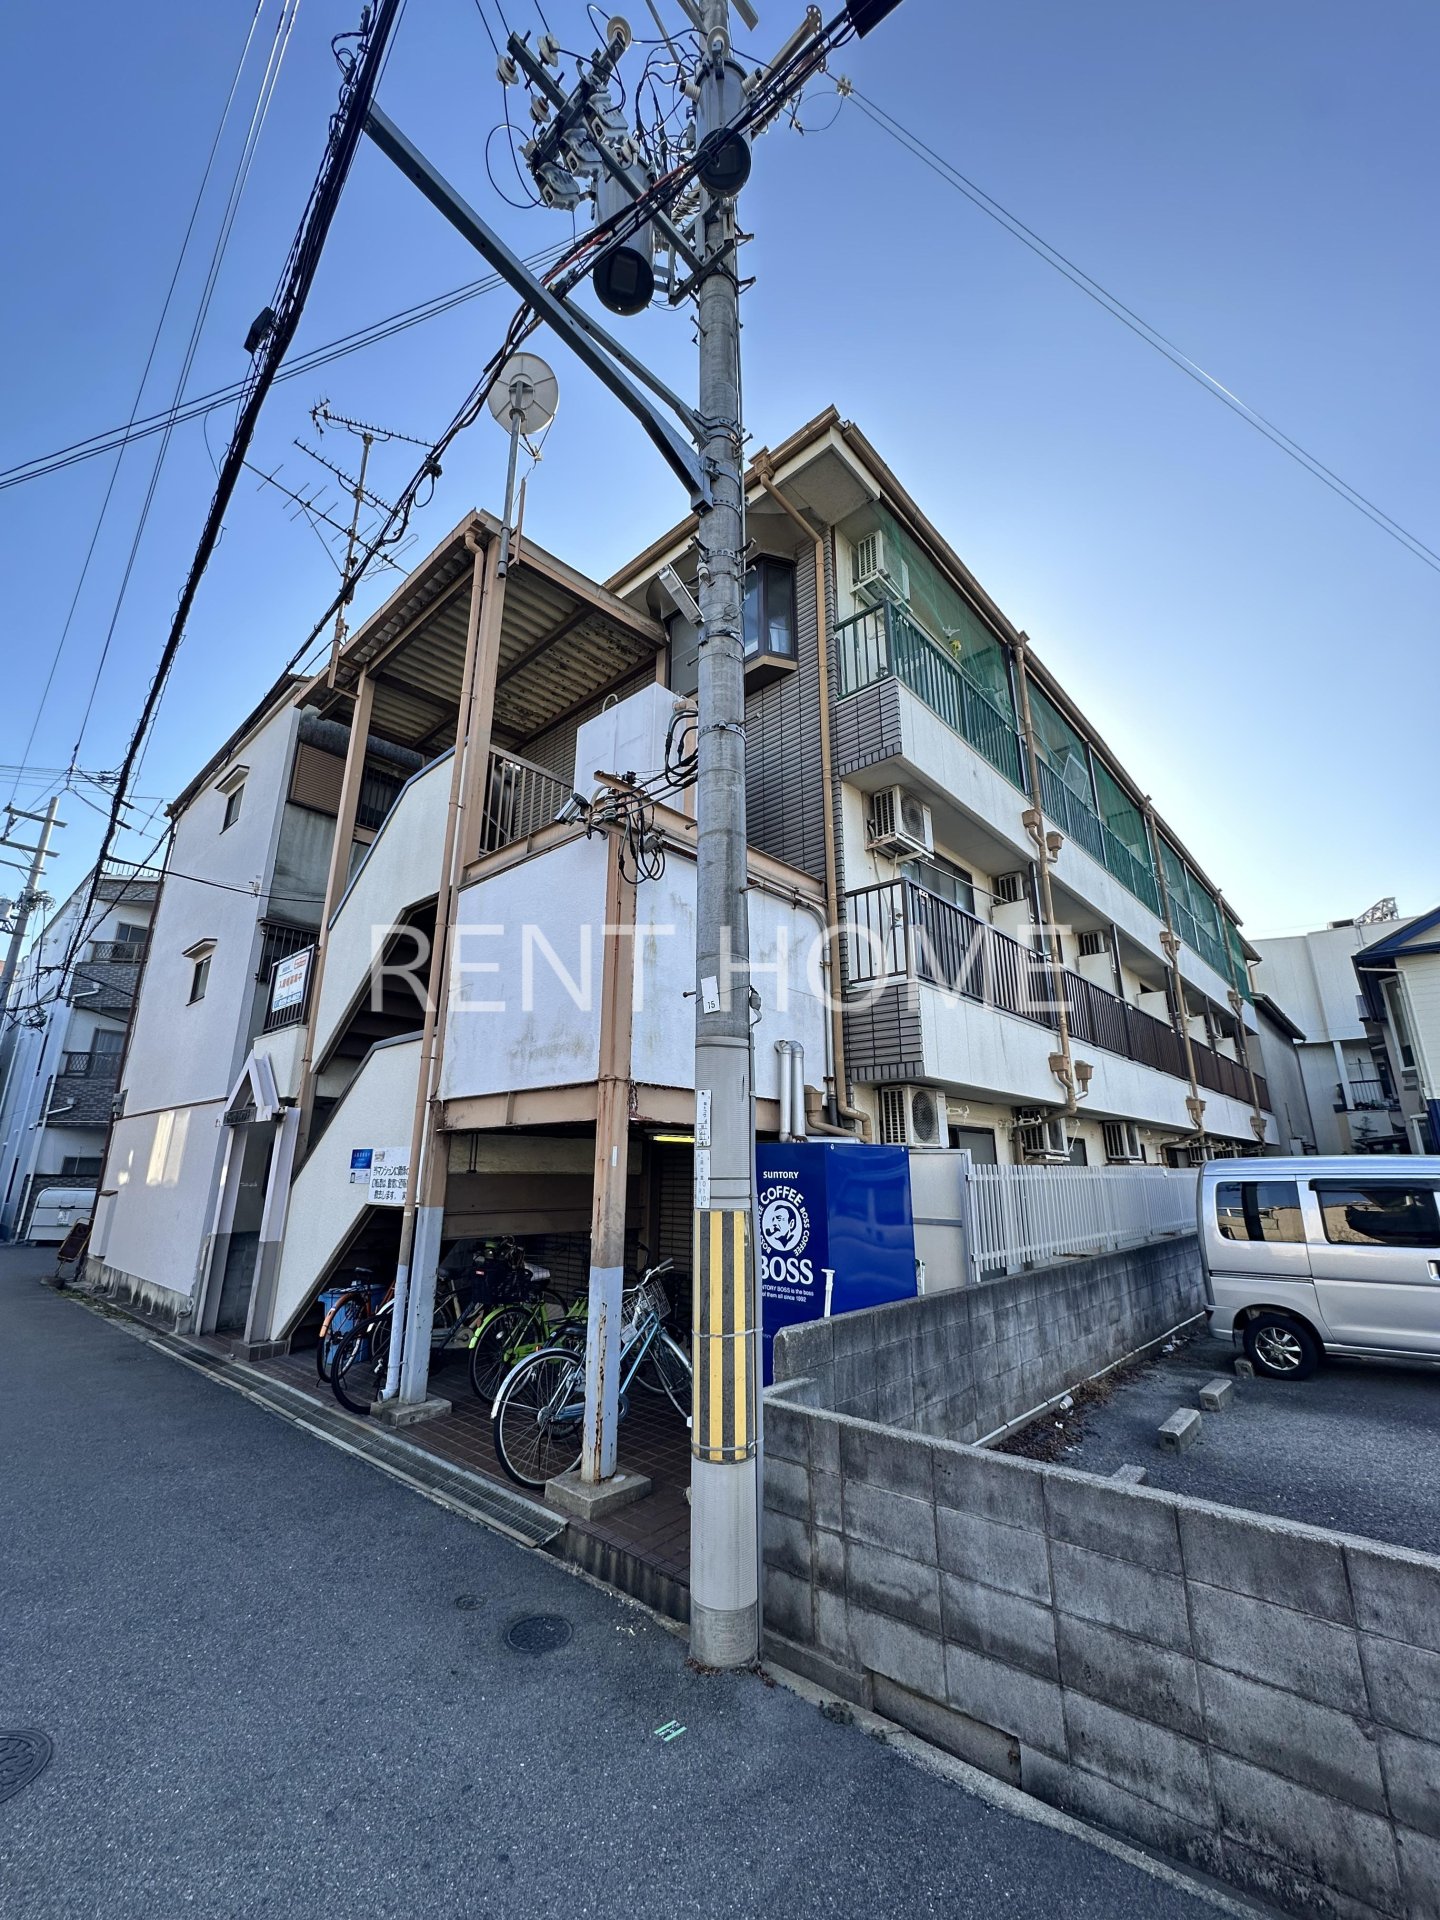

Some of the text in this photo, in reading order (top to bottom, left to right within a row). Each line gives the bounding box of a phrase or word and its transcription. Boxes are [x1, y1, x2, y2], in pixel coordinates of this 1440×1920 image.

[707, 1000, 716, 1010] 15
[760, 1185, 804, 1207] COFFEE
[761, 1255, 814, 1285] BOSS
